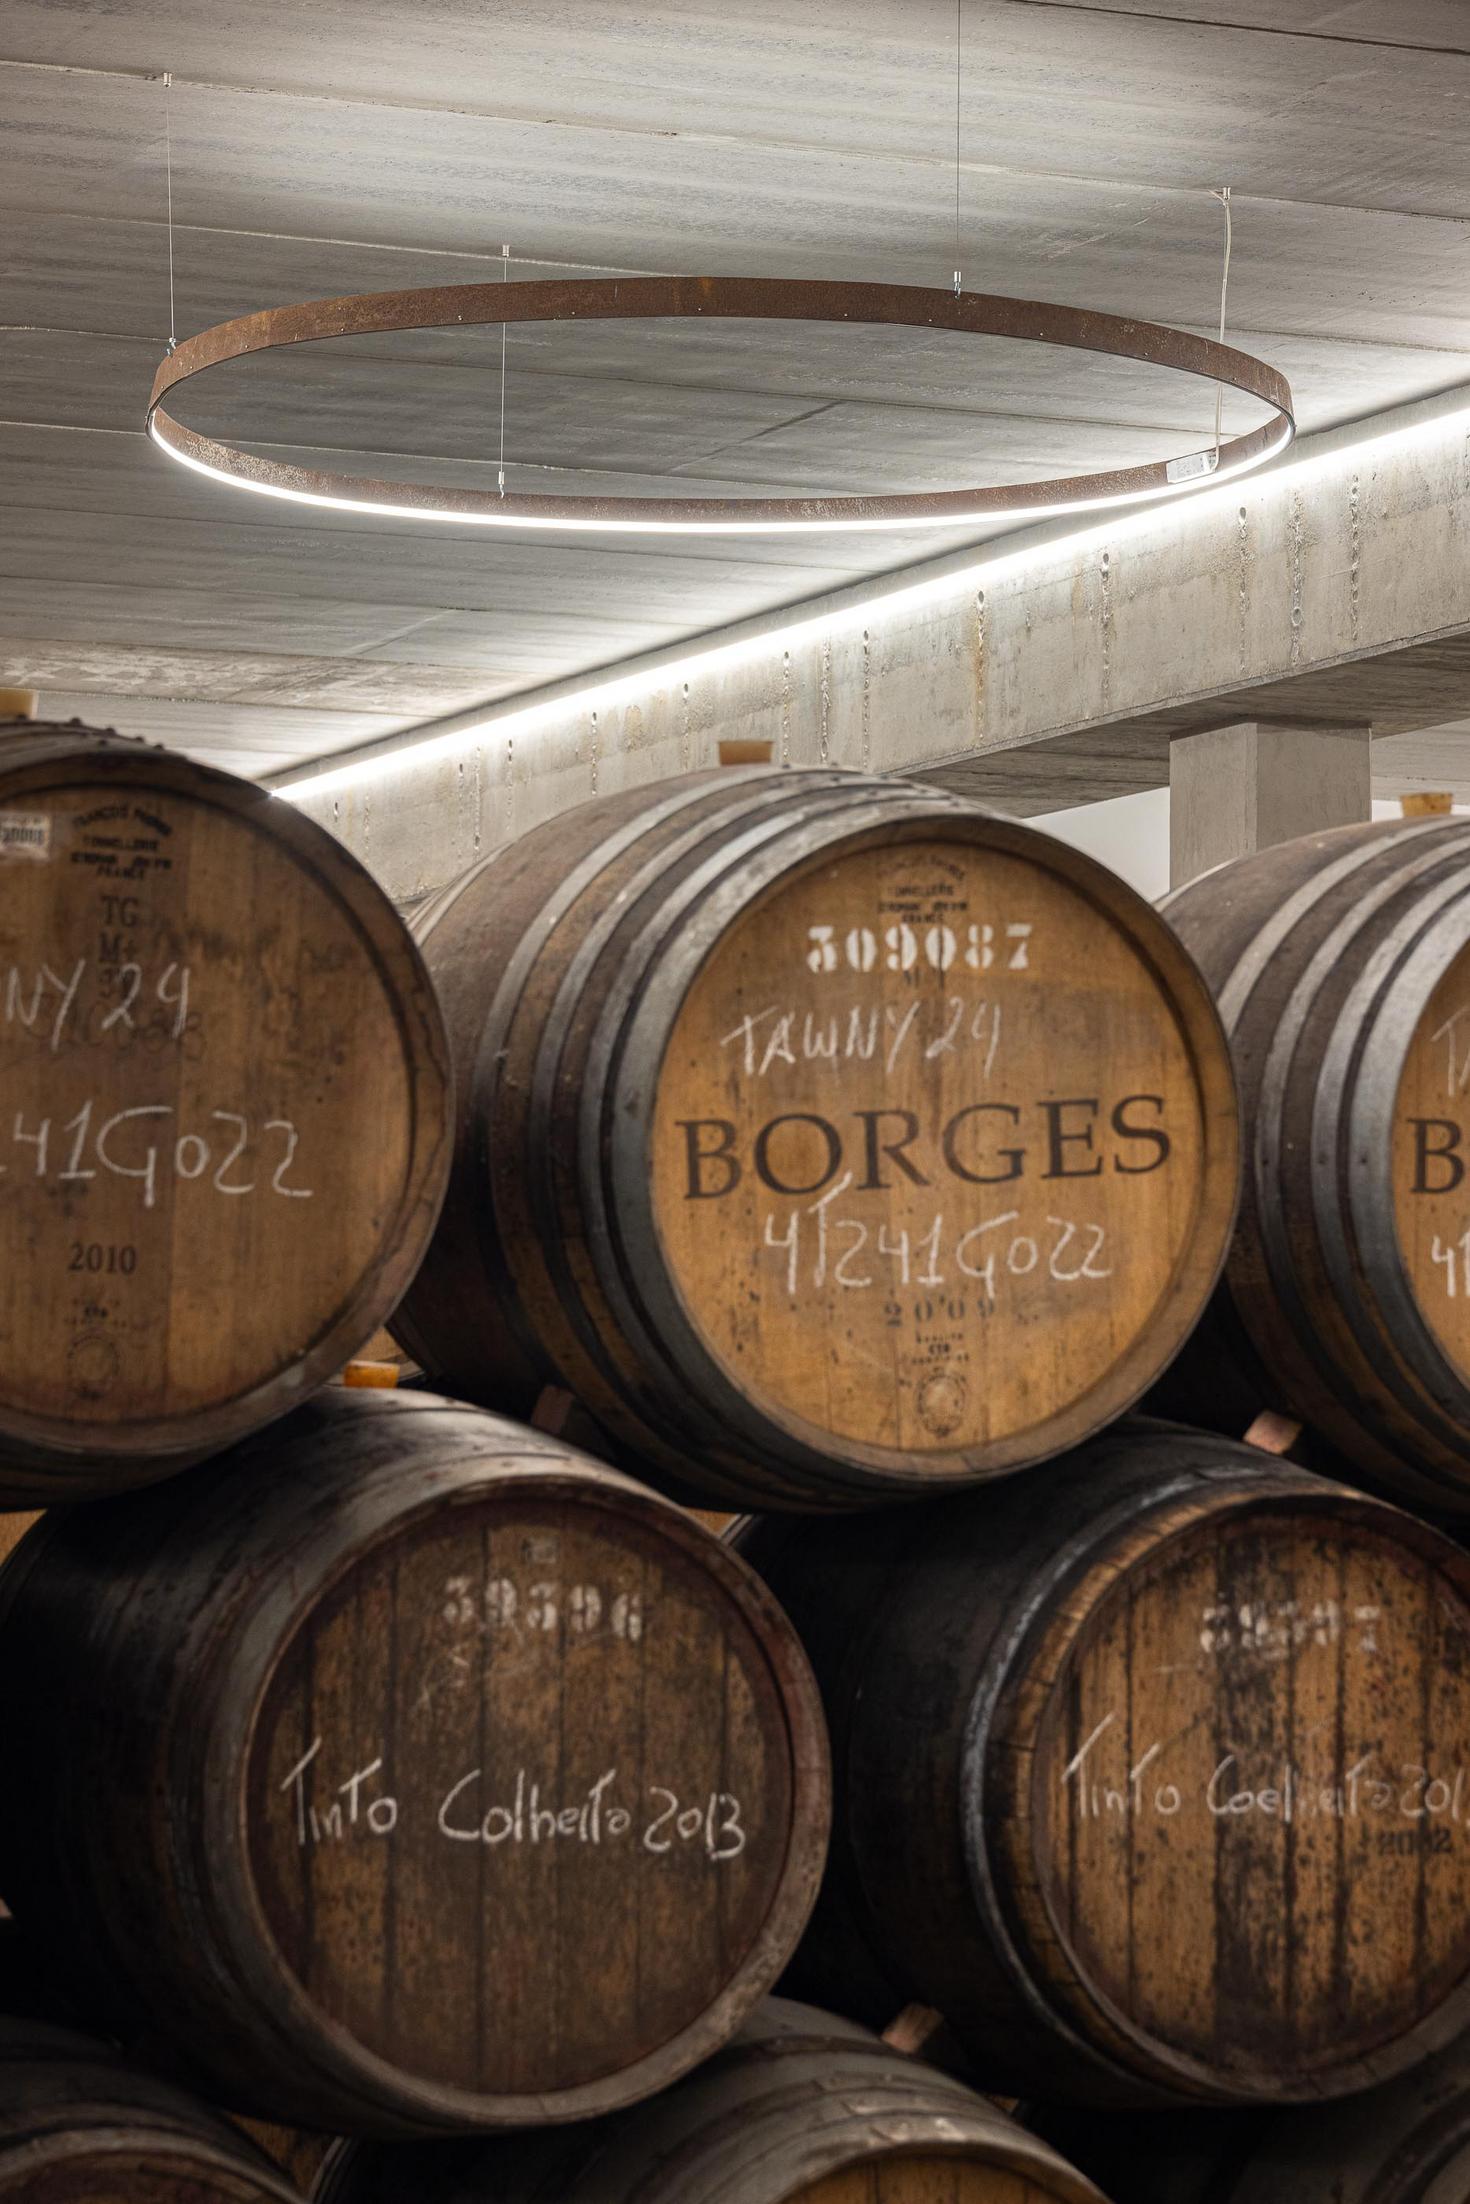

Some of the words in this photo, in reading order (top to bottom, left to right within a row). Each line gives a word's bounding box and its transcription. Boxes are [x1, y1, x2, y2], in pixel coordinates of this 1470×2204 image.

[806, 923, 1033, 974] 309087
[720, 1000, 920, 1076] TAWNY
[674, 1094, 1172, 1200] BORGES
[67, 1240, 137, 1275] 2010
[643, 1785, 746, 1861] 2013
